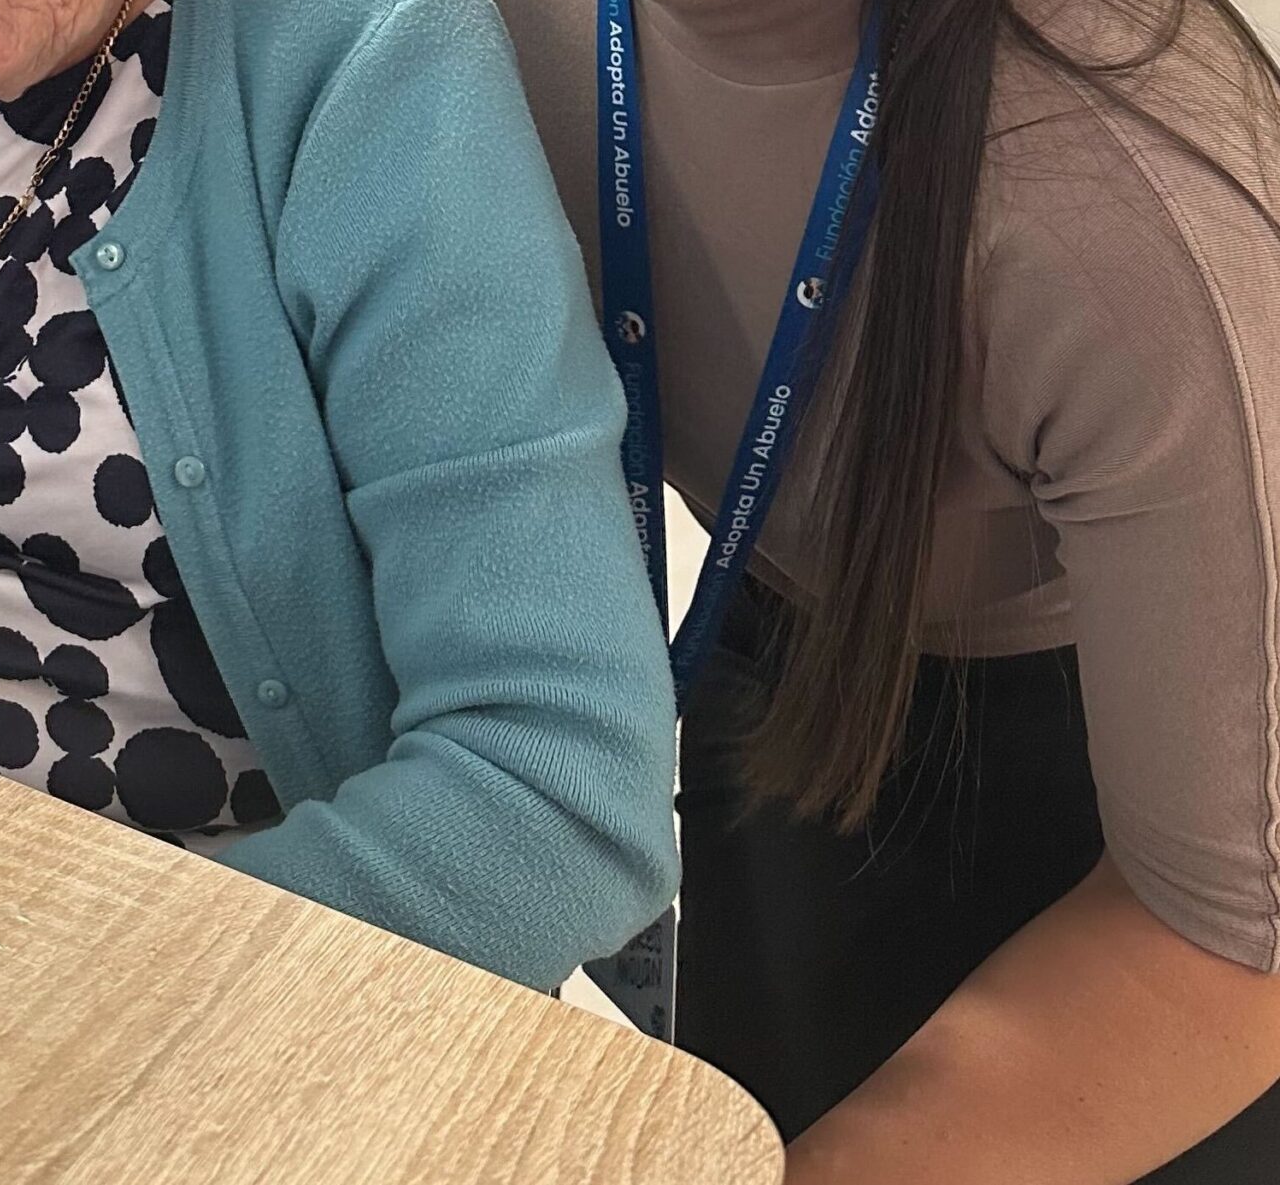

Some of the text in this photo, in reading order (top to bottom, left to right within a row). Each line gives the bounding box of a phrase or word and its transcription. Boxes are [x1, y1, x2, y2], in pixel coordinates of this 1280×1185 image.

[606, 20, 626, 106] Adopta
[612, 110, 628, 141] Un
[614, 145, 635, 228] Abuelo
[816, 148, 865, 262] Fundación
[752, 384, 792, 460] Abuelo
[740, 462, 767, 491] Un
[716, 495, 756, 568] Adopta
